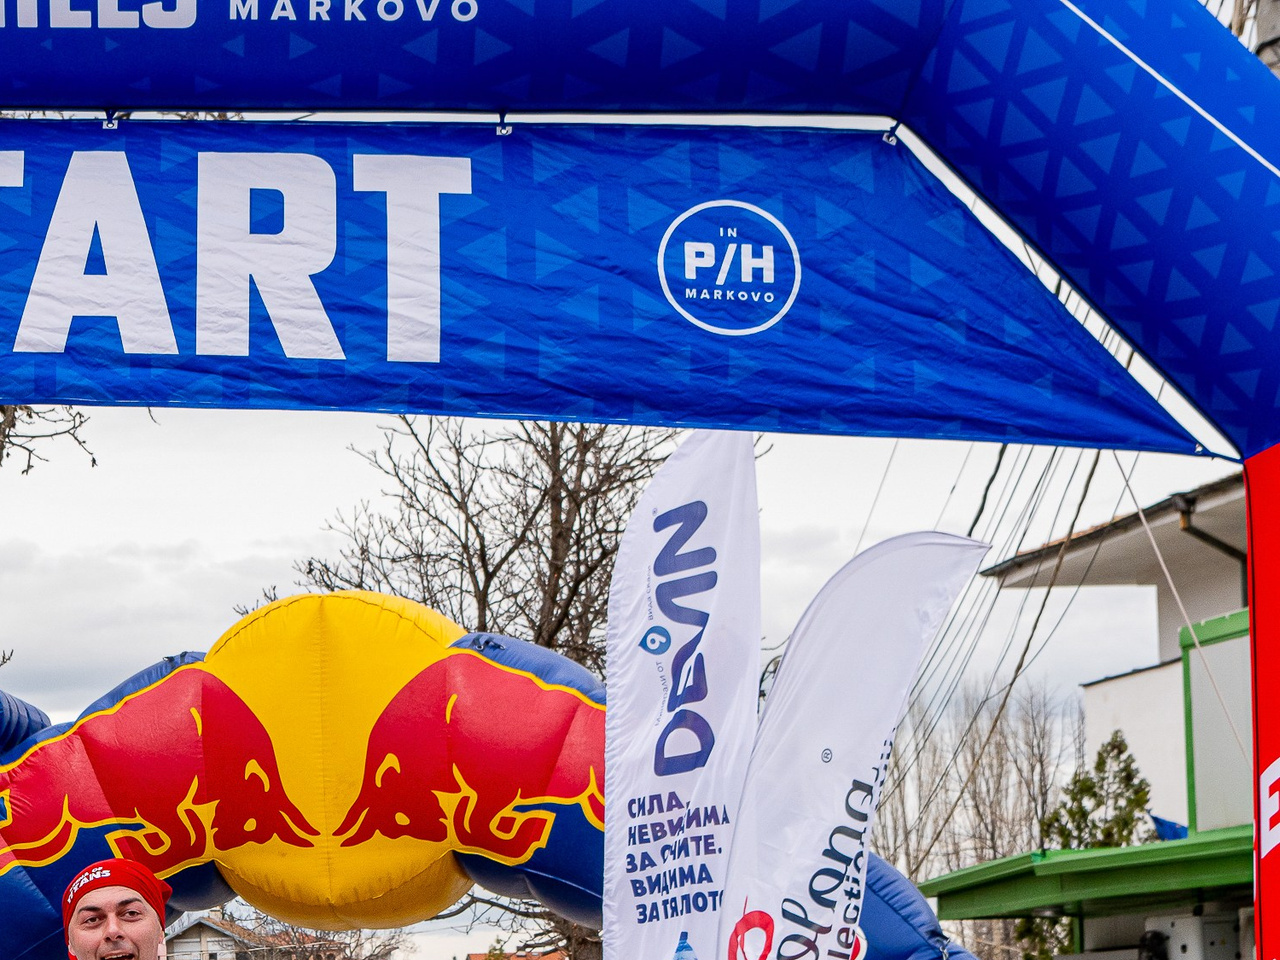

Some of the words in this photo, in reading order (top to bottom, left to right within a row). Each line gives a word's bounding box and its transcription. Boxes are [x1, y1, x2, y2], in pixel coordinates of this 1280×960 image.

[719, 226, 738, 238] IN
[684, 241, 775, 286] P/H
[685, 288, 775, 303] MARKOVO
[652, 500, 718, 777] DEVIN
[627, 791, 691, 819] СИЛА,
[625, 851, 657, 874] ЗА
[630, 863, 714, 897] ВИДИМА
